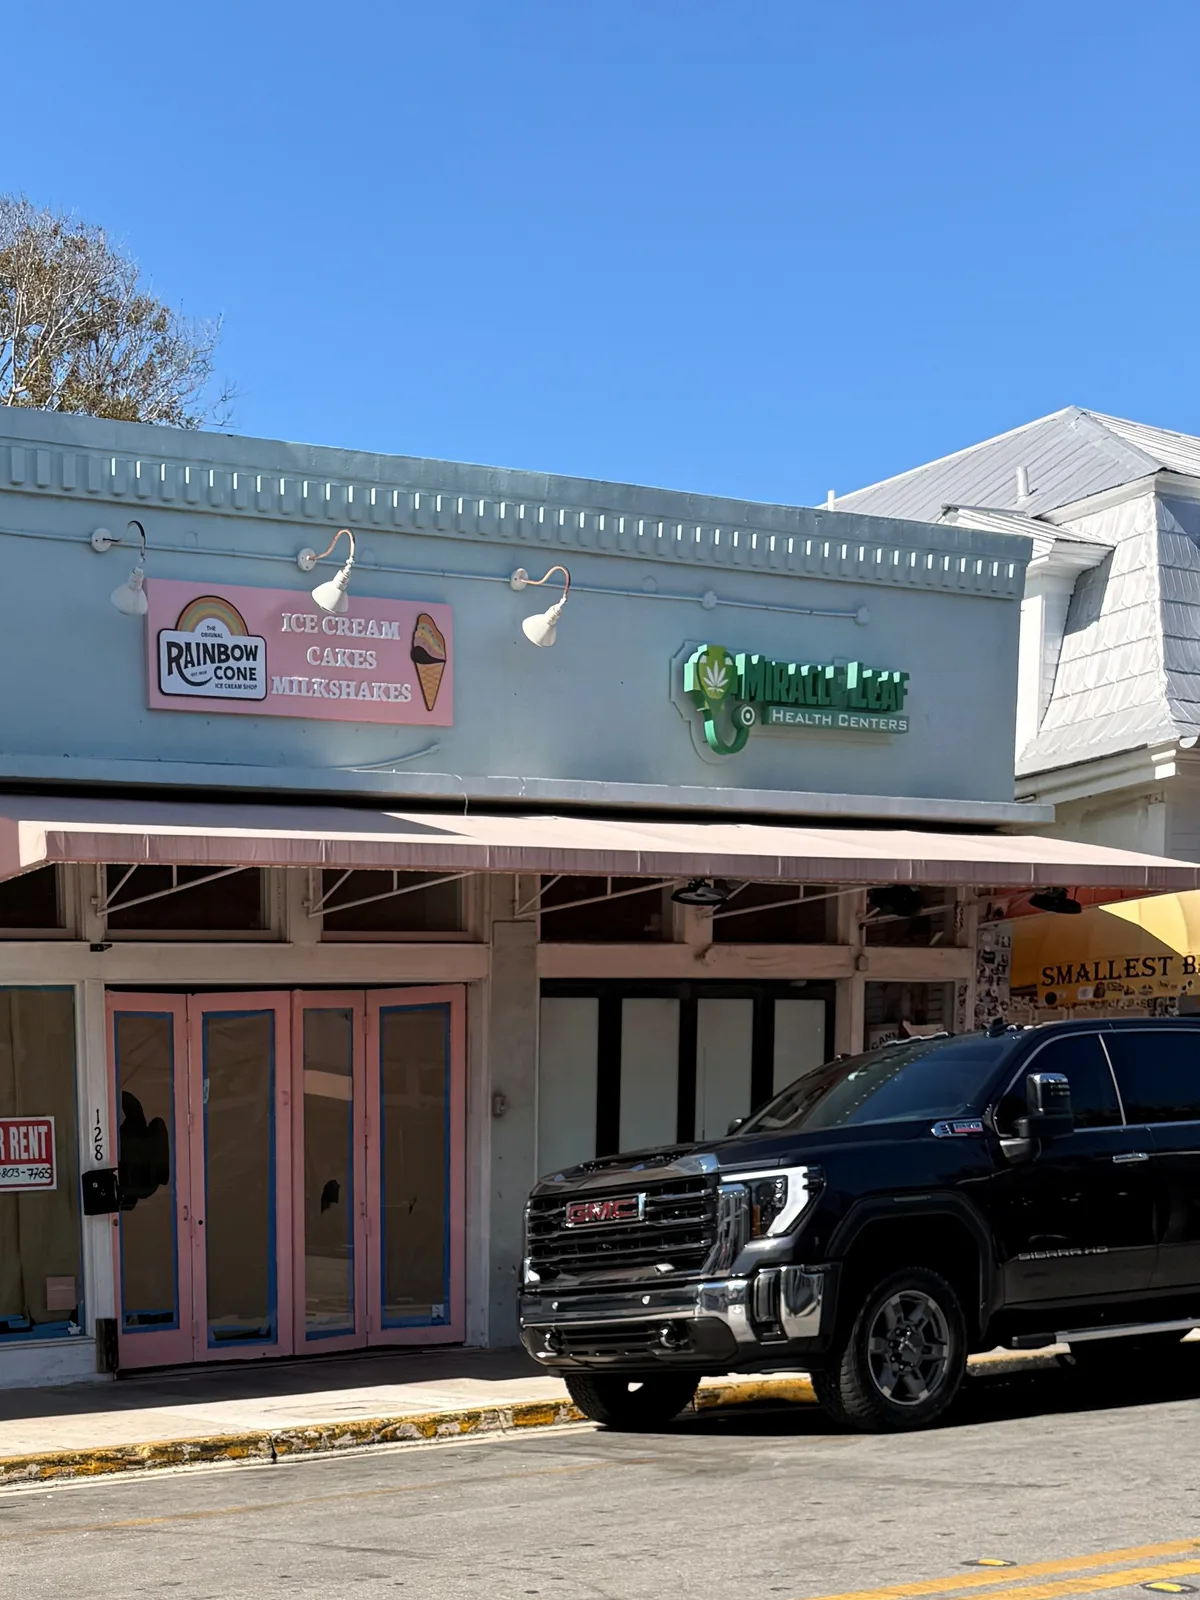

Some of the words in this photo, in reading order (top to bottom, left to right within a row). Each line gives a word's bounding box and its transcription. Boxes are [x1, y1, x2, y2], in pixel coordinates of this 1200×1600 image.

[281, 612, 318, 634] ICE
[322, 615, 401, 640] CREAM
[166, 641, 259, 686] RAINBOW
[306, 646, 378, 670] CAKES
[213, 665, 258, 682] CONE
[847, 661, 910, 711] LEAF
[271, 676, 412, 703] MILKSHAKES
[772, 709, 833, 727] HEALTH
[838, 714, 908, 731] CENTERS
[1041, 955, 1174, 987] SMALLEST
[1182, 955, 1200, 976] B
[9, 1125, 48, 1160] RENT
[94, 1108, 103, 1161] 128
[568, 1197, 637, 1223] GMC
[1018, 1248, 1082, 1260] SIERRA
